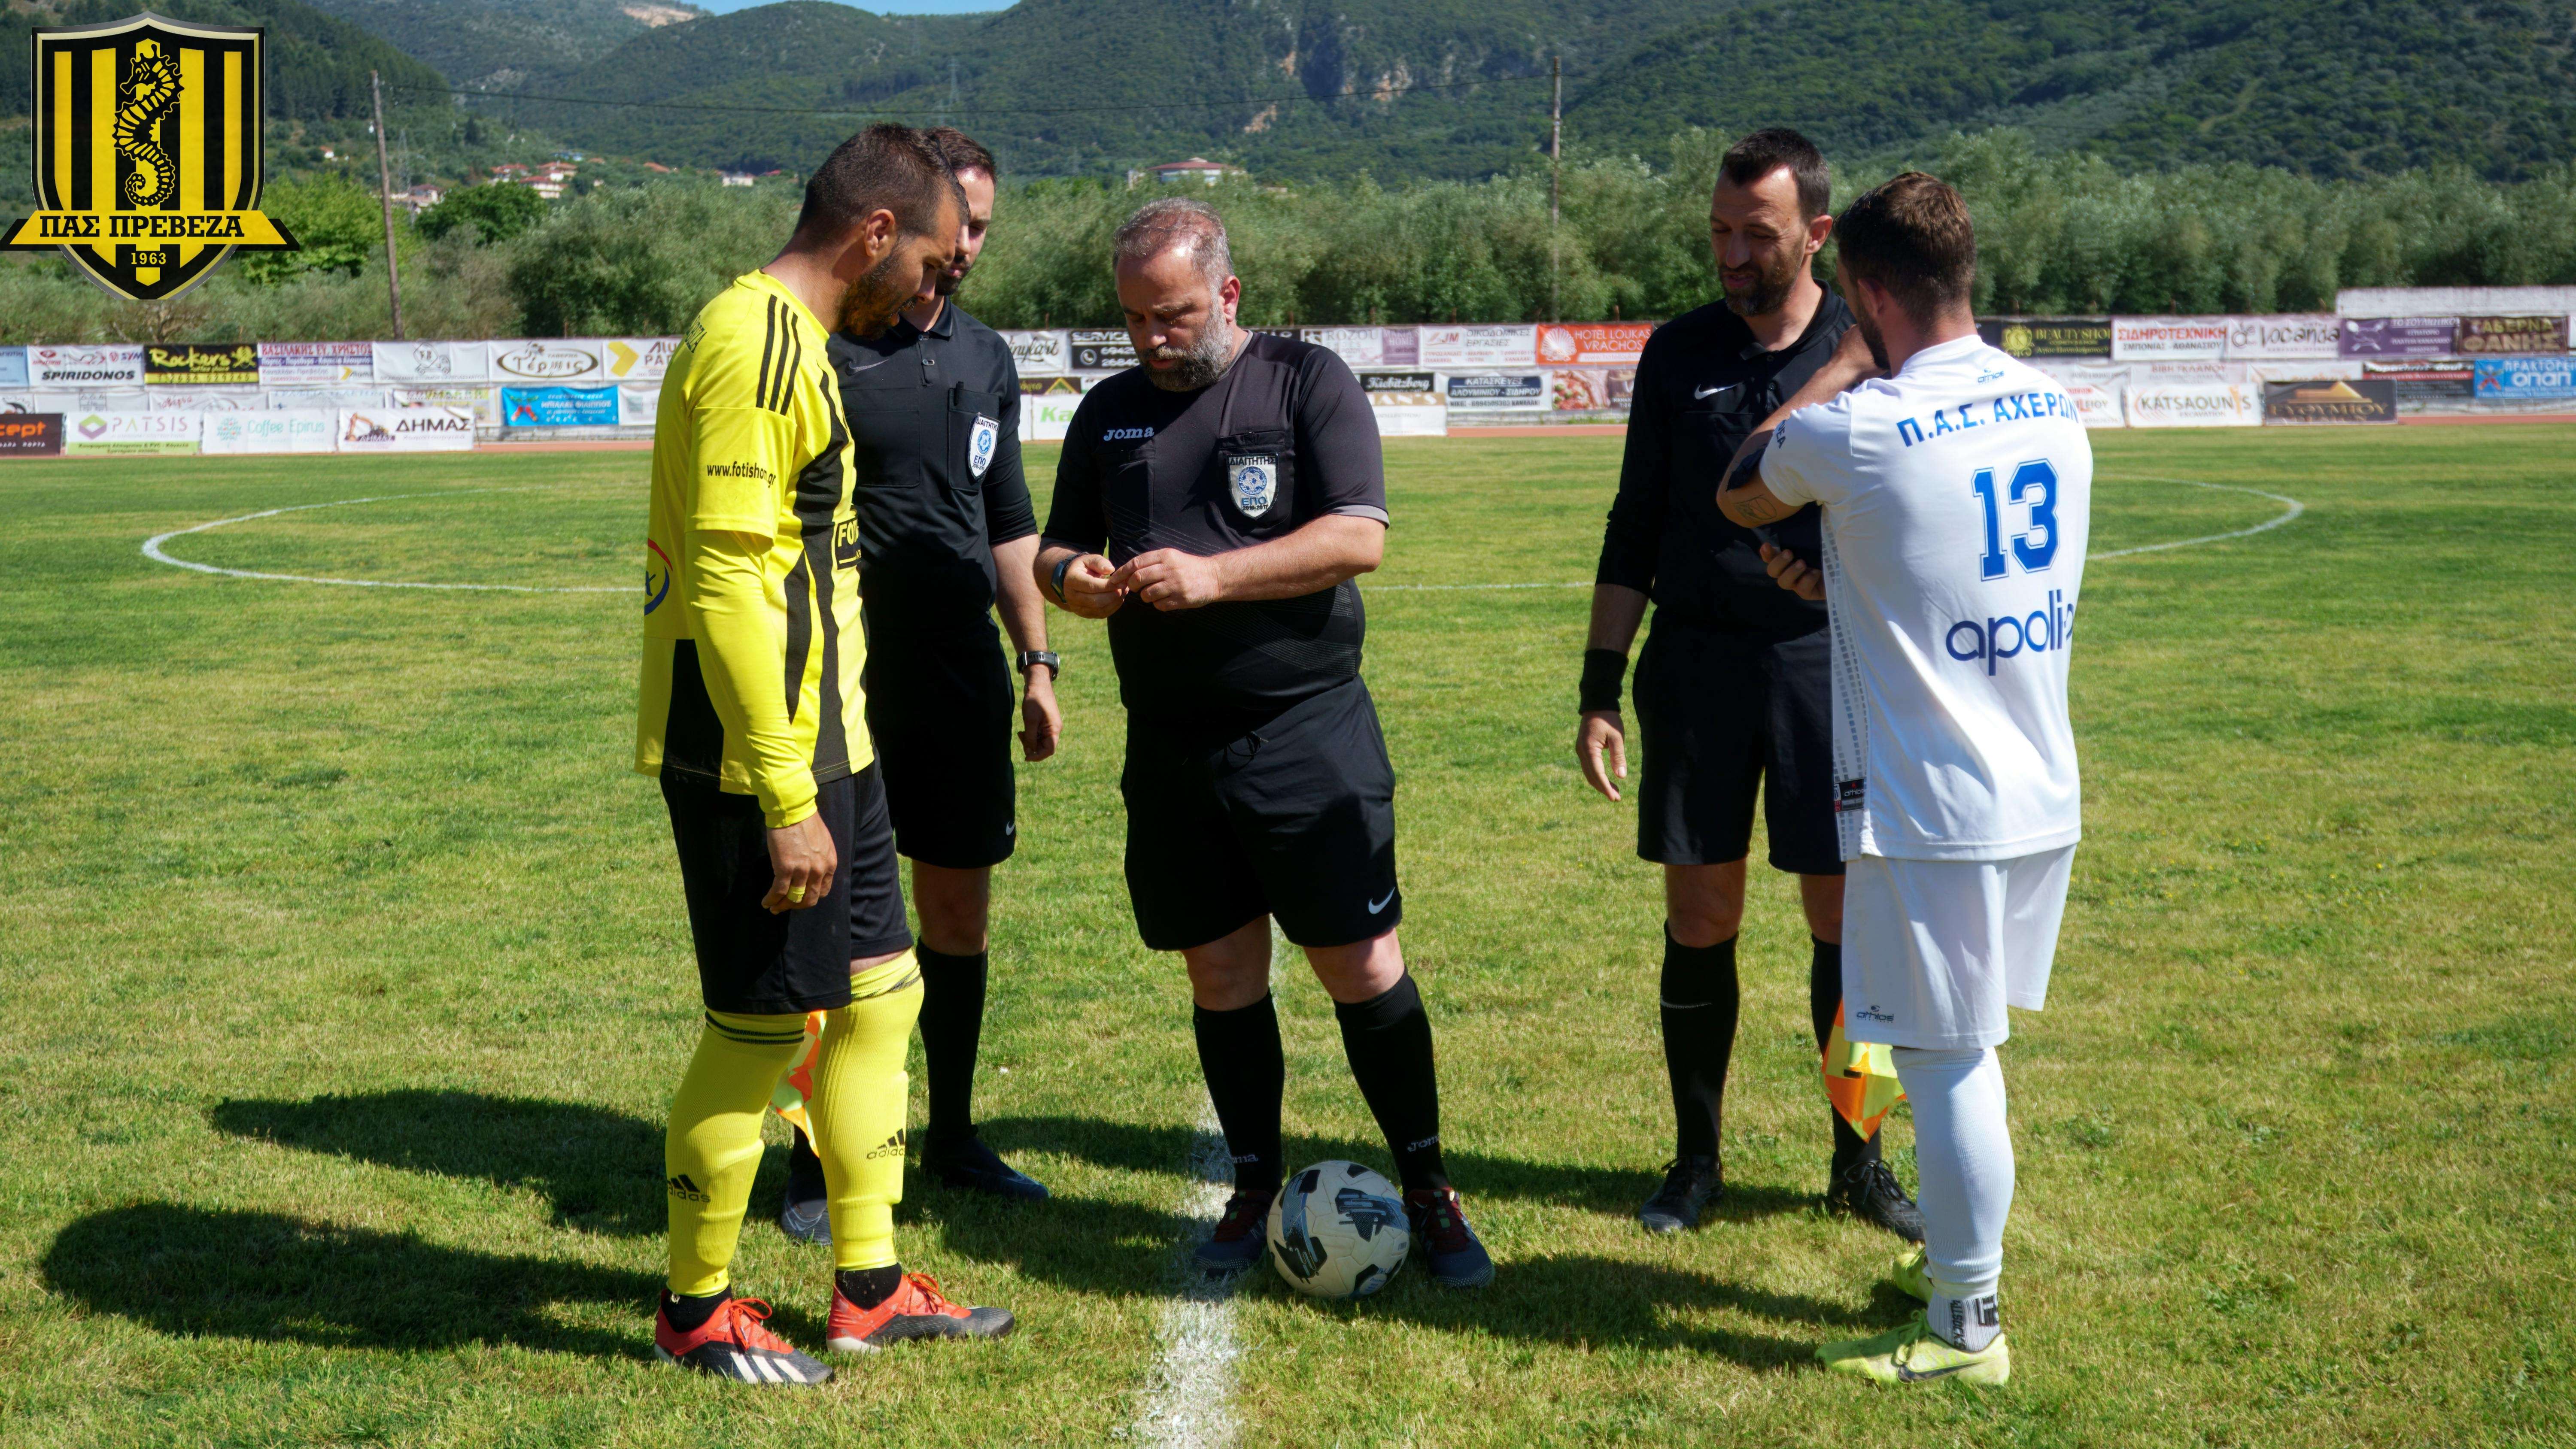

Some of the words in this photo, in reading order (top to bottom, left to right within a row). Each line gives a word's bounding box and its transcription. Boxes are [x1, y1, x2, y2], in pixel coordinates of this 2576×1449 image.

[2470, 318, 2554, 333] ΤΑΒΕΡΝΑ
[1466, 329, 1531, 337] ΟΙΚΟΔΟΜΙΚΕΣ
[1575, 330, 1606, 340] HOTEL
[1610, 329, 1651, 339] LOUKAS
[2036, 328, 2079, 340] BEAUTY
[2117, 327, 2227, 341] ΣΙΔΗΡΟΤΕΧΝΙΚΗ
[262, 344, 313, 355] ΒΑΣΙΛΑΚΗΣ
[1583, 340, 1643, 351] VRACHOS
[2173, 342, 2222, 350] ΑΘΑΝΑΣΙΟΥ
[149, 346, 231, 367] Rockers
[42, 370, 135, 381] SPIRIDONOS
[1464, 377, 1524, 385] ΚΑΤΑΣΚΕΥΕΣ
[1451, 388, 1501, 396] ΑΛΟΥΜΙΝΙΟΥ
[1507, 388, 1541, 396] ΣΙΔΗΡΟΥ
[112, 416, 188, 432] PATSIS
[248, 419, 284, 437] Coffee
[289, 418, 325, 437] Epirus
[396, 418, 471, 432] ΔΗΜΑΣ
[973, 455, 986, 466] ΕΠΟ
[1230, 457, 1276, 466] ΔΙΑΙΤΗΤΗΣ
[1242, 496, 1267, 506] ΕΠΟ
[1971, 458, 2061, 582] 13
[668, 1186, 711, 1203] didas
